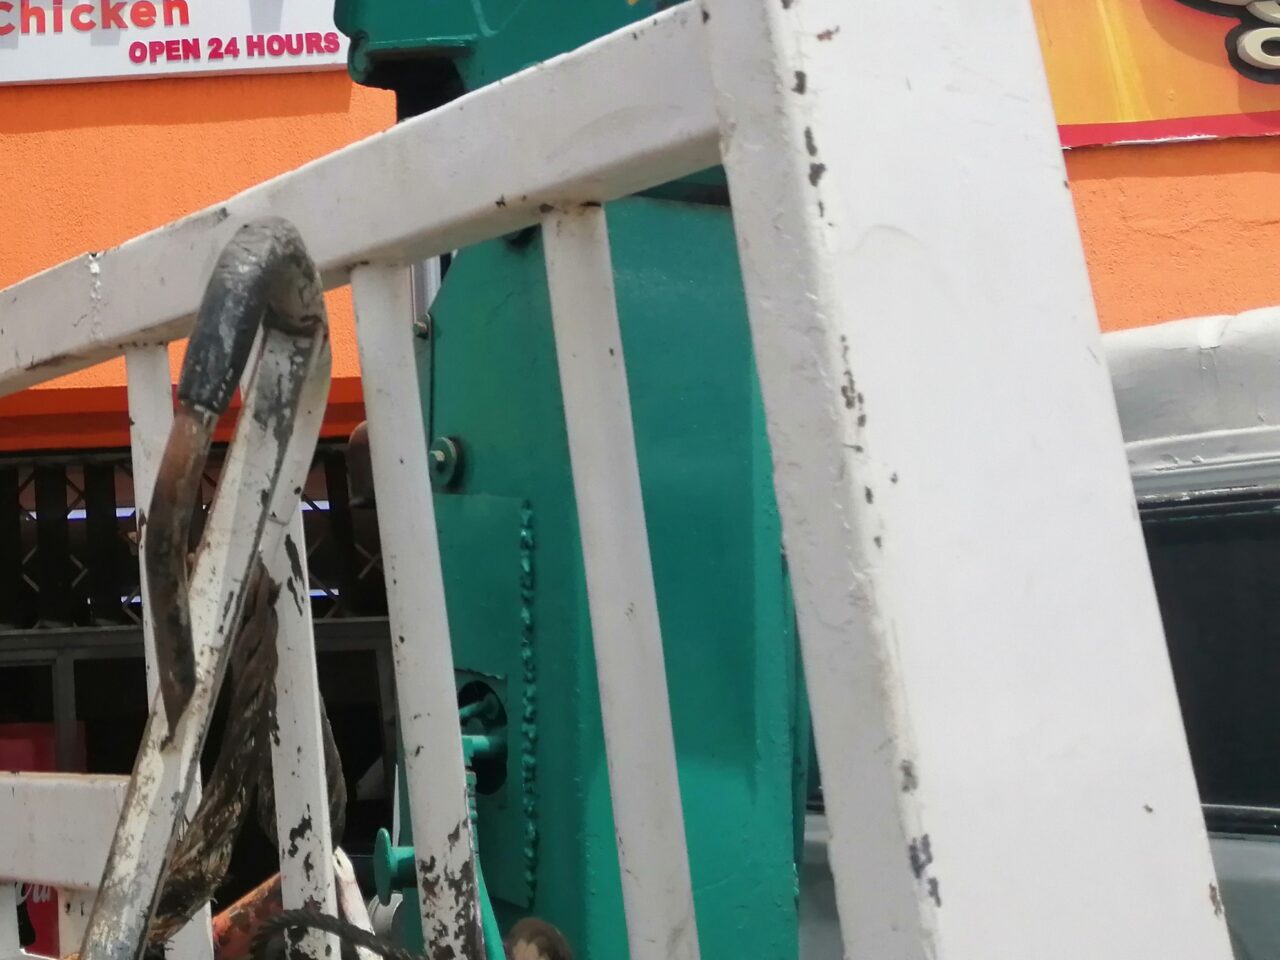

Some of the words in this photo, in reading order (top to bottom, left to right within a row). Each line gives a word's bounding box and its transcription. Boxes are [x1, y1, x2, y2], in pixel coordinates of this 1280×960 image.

[128, 39, 201, 64] OPEN
[208, 37, 240, 60] 24
[247, 32, 340, 57] HOURS
